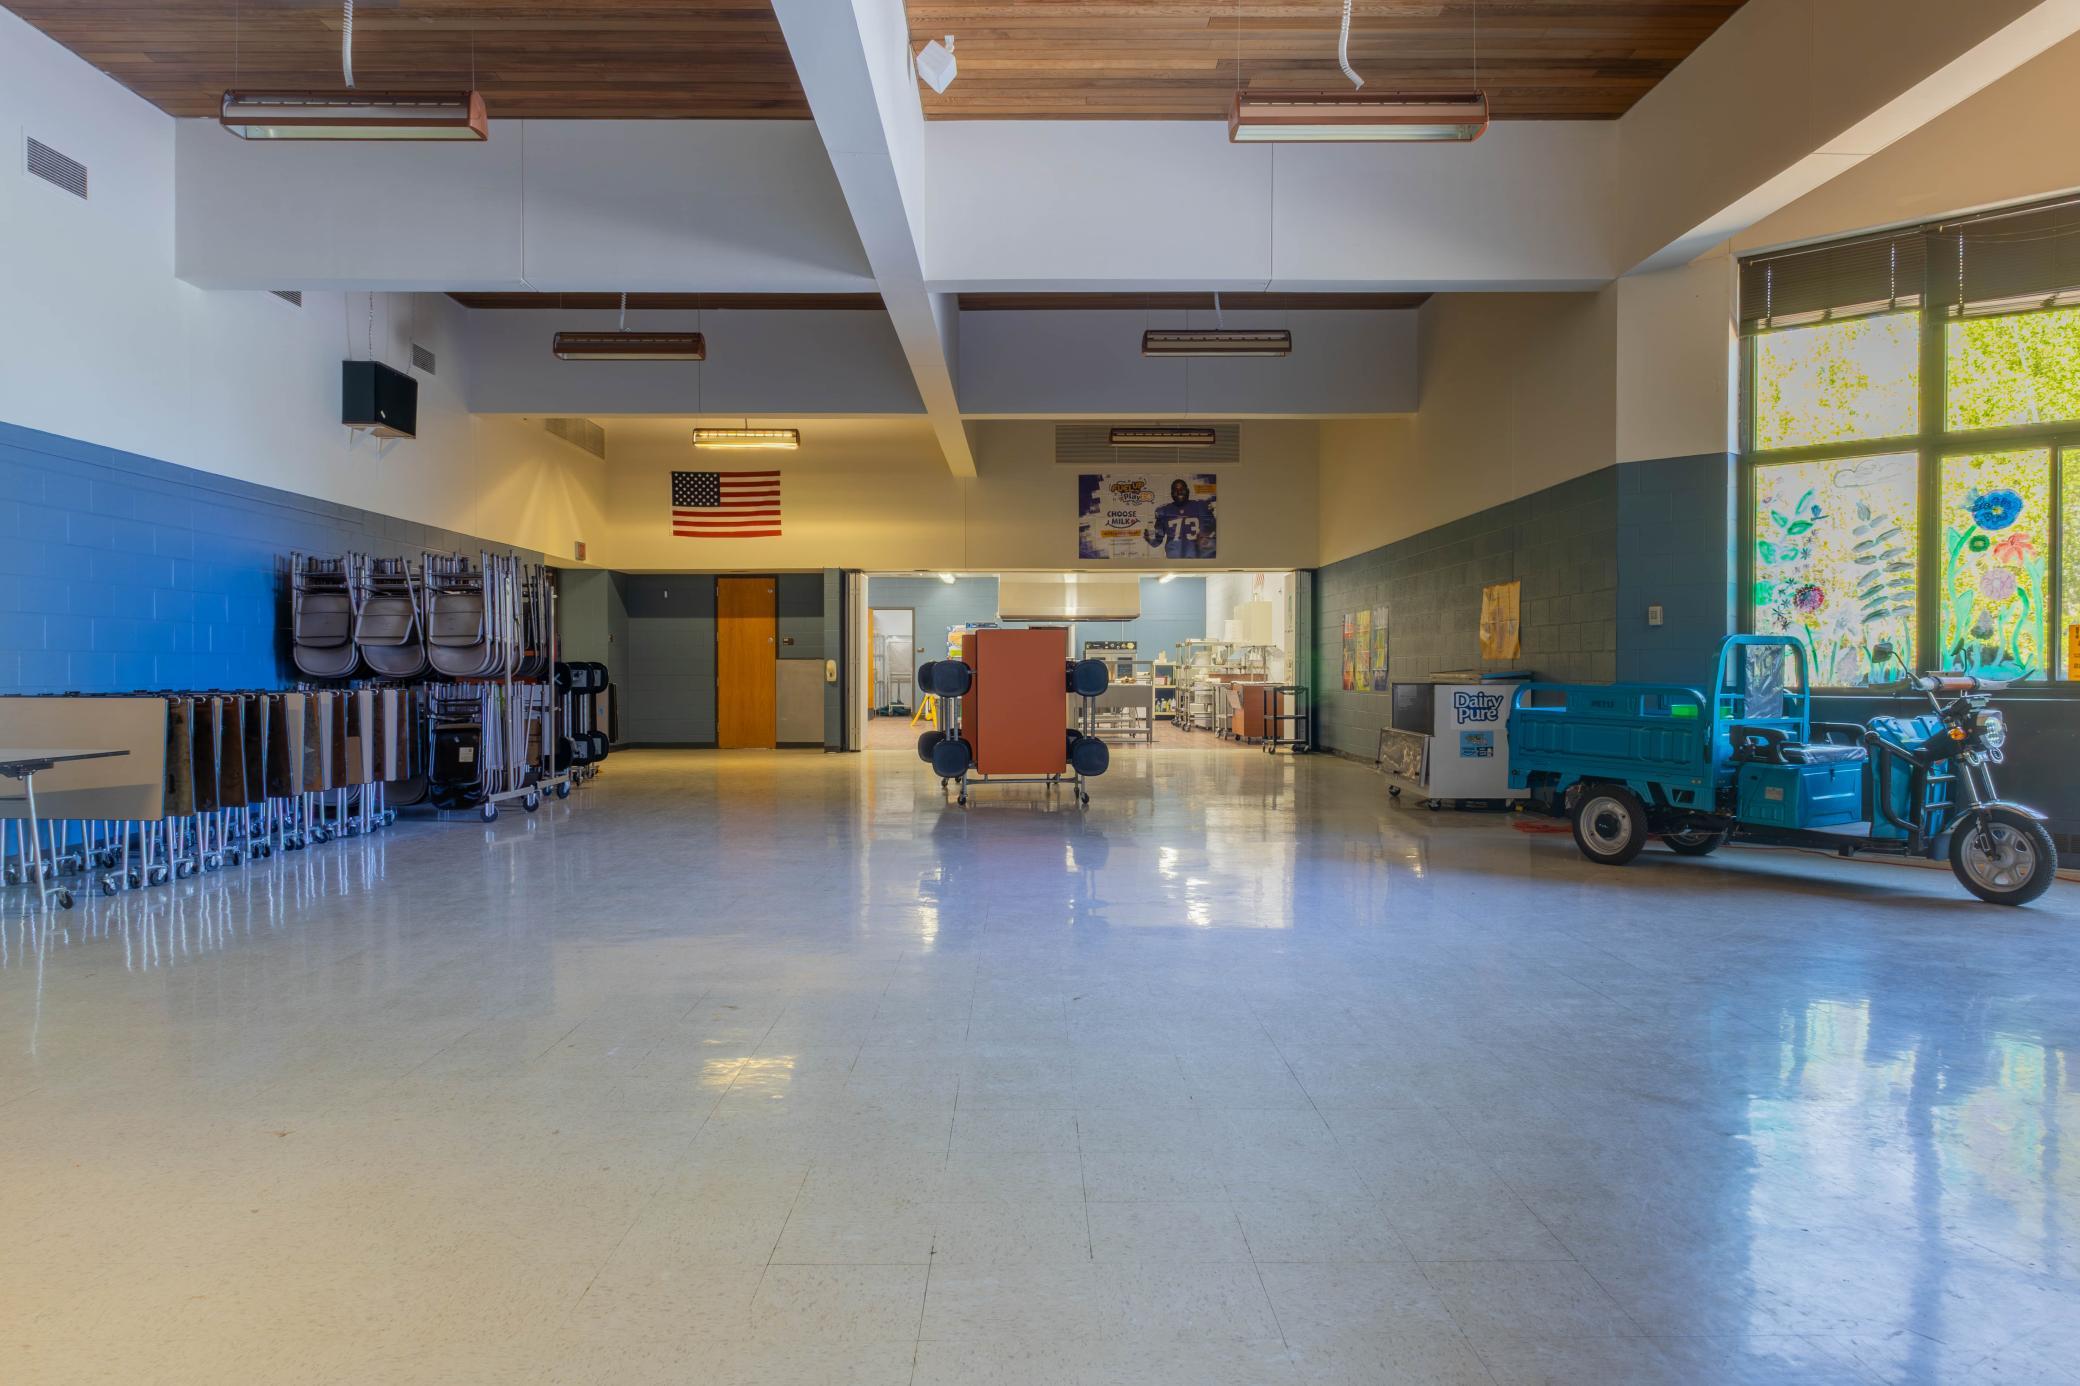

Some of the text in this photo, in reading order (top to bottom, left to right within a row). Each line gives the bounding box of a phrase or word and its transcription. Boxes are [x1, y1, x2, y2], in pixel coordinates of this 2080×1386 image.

[1168, 517, 1200, 540] 73
[1454, 691, 1504, 710] Dairy
[1458, 707, 1499, 724] Pure
